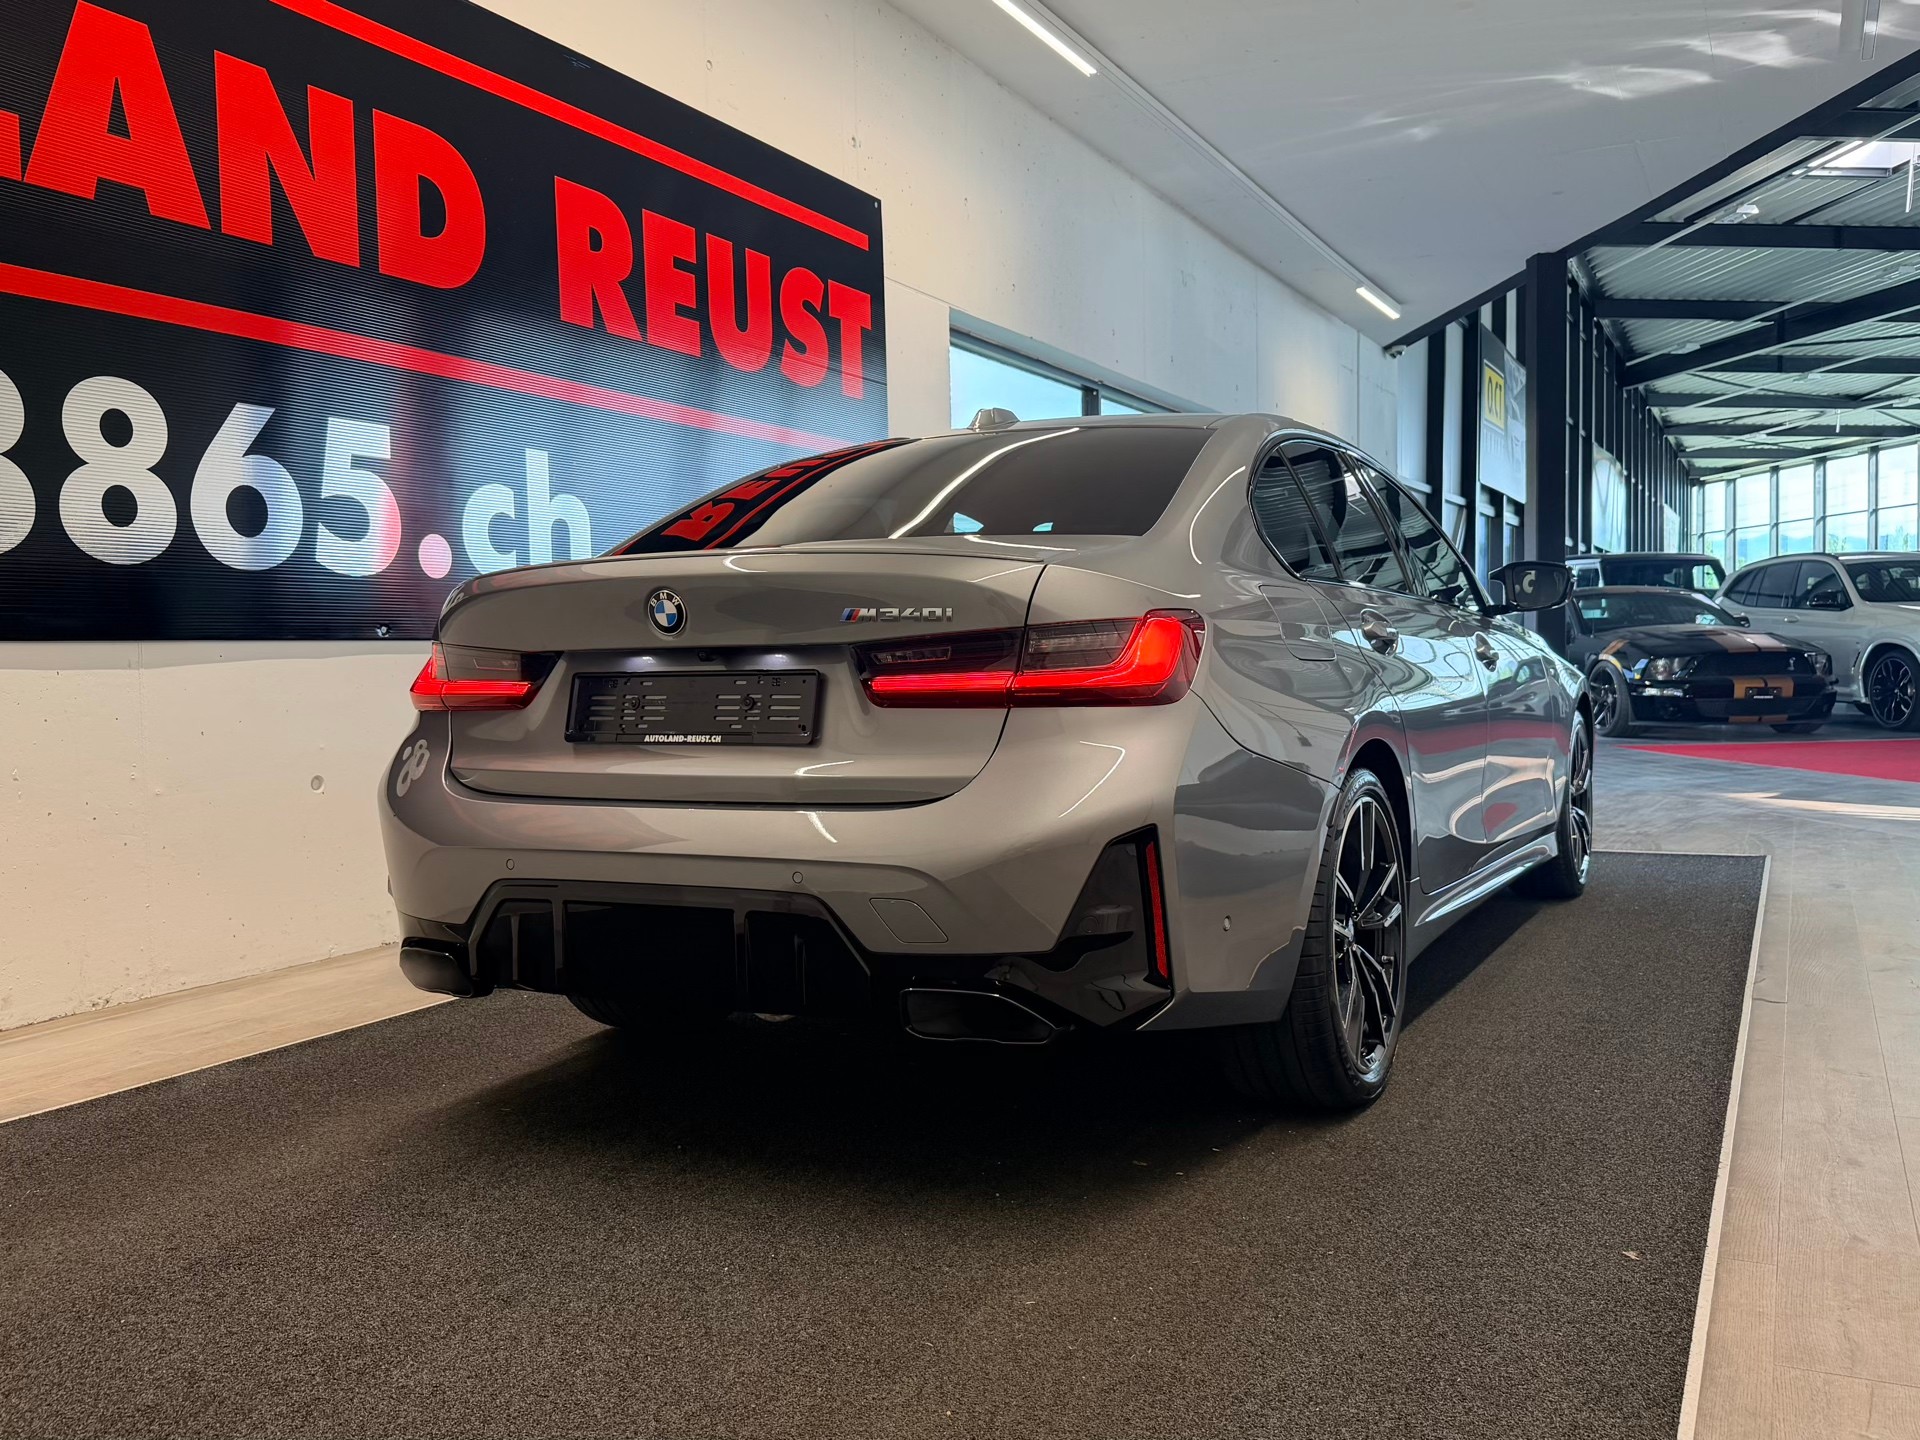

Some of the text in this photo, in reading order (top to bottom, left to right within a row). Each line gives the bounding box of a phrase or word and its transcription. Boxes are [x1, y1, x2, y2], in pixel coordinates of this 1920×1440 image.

[0, 0, 872, 400] AND REUST
[650, 592, 681, 607] BMW
[858, 607, 953, 622] M340i
[644, 734, 722, 743] AUTOLAND-REUST.CH
